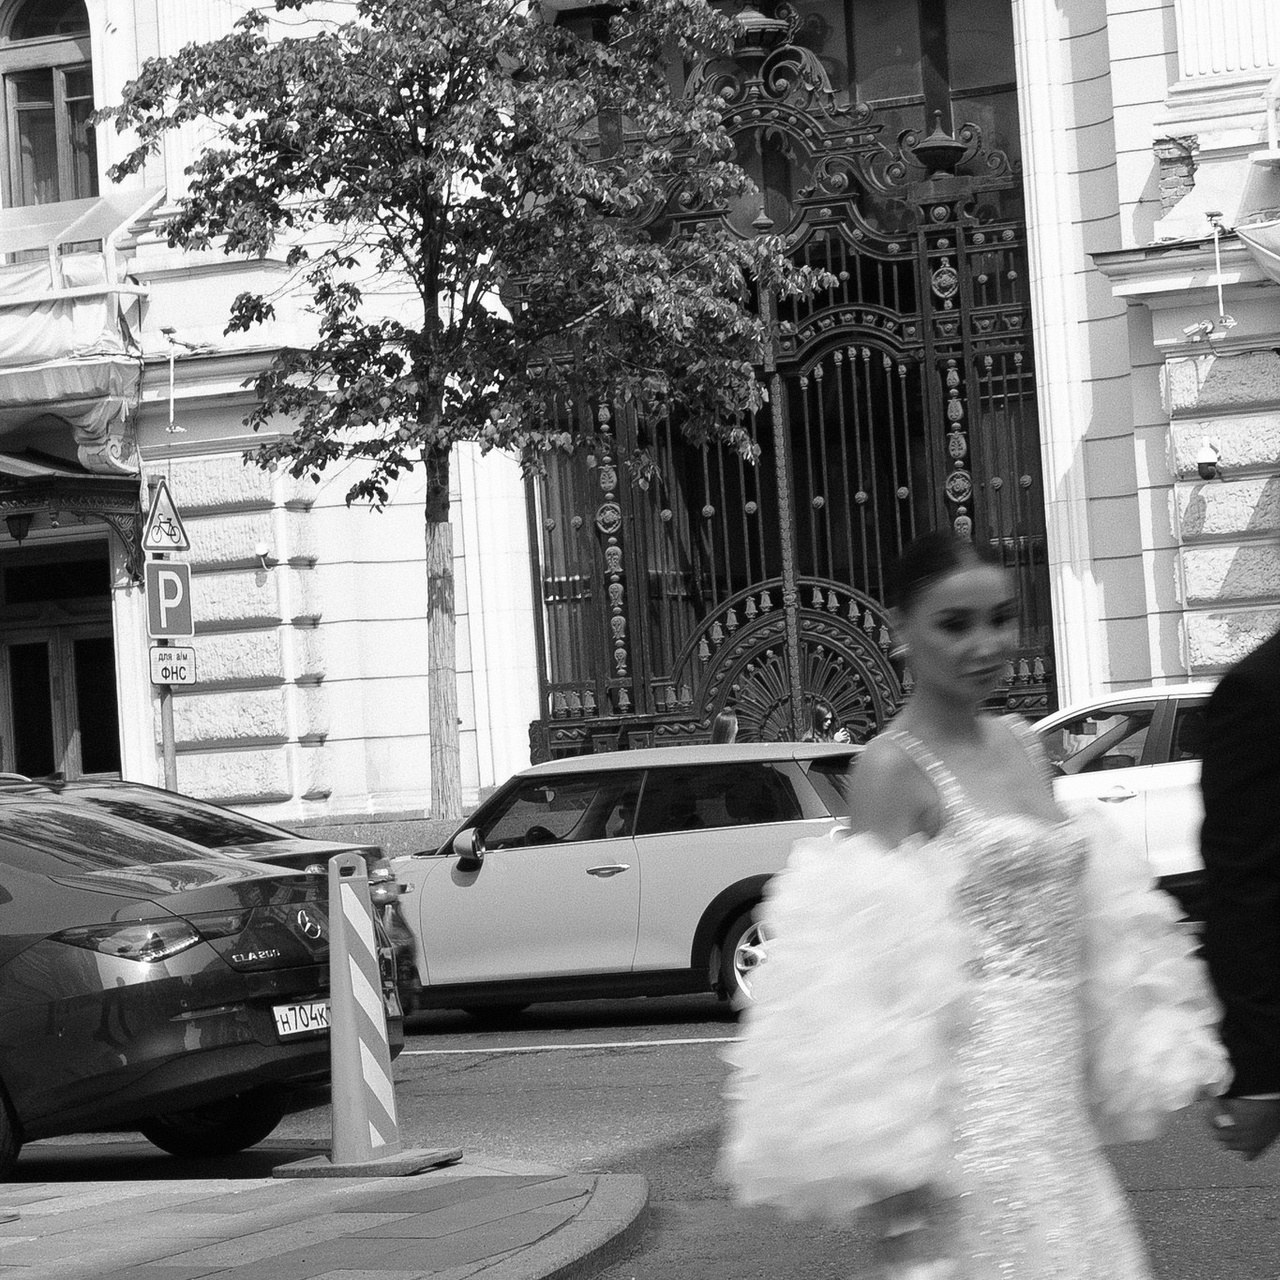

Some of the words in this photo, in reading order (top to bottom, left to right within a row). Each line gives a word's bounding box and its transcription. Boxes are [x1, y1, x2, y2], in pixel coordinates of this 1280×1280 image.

[158, 570, 184, 629] P
[158, 652, 173, 662] для
[176, 651, 188, 661] а/м
[161, 665, 187, 681] ФНС
